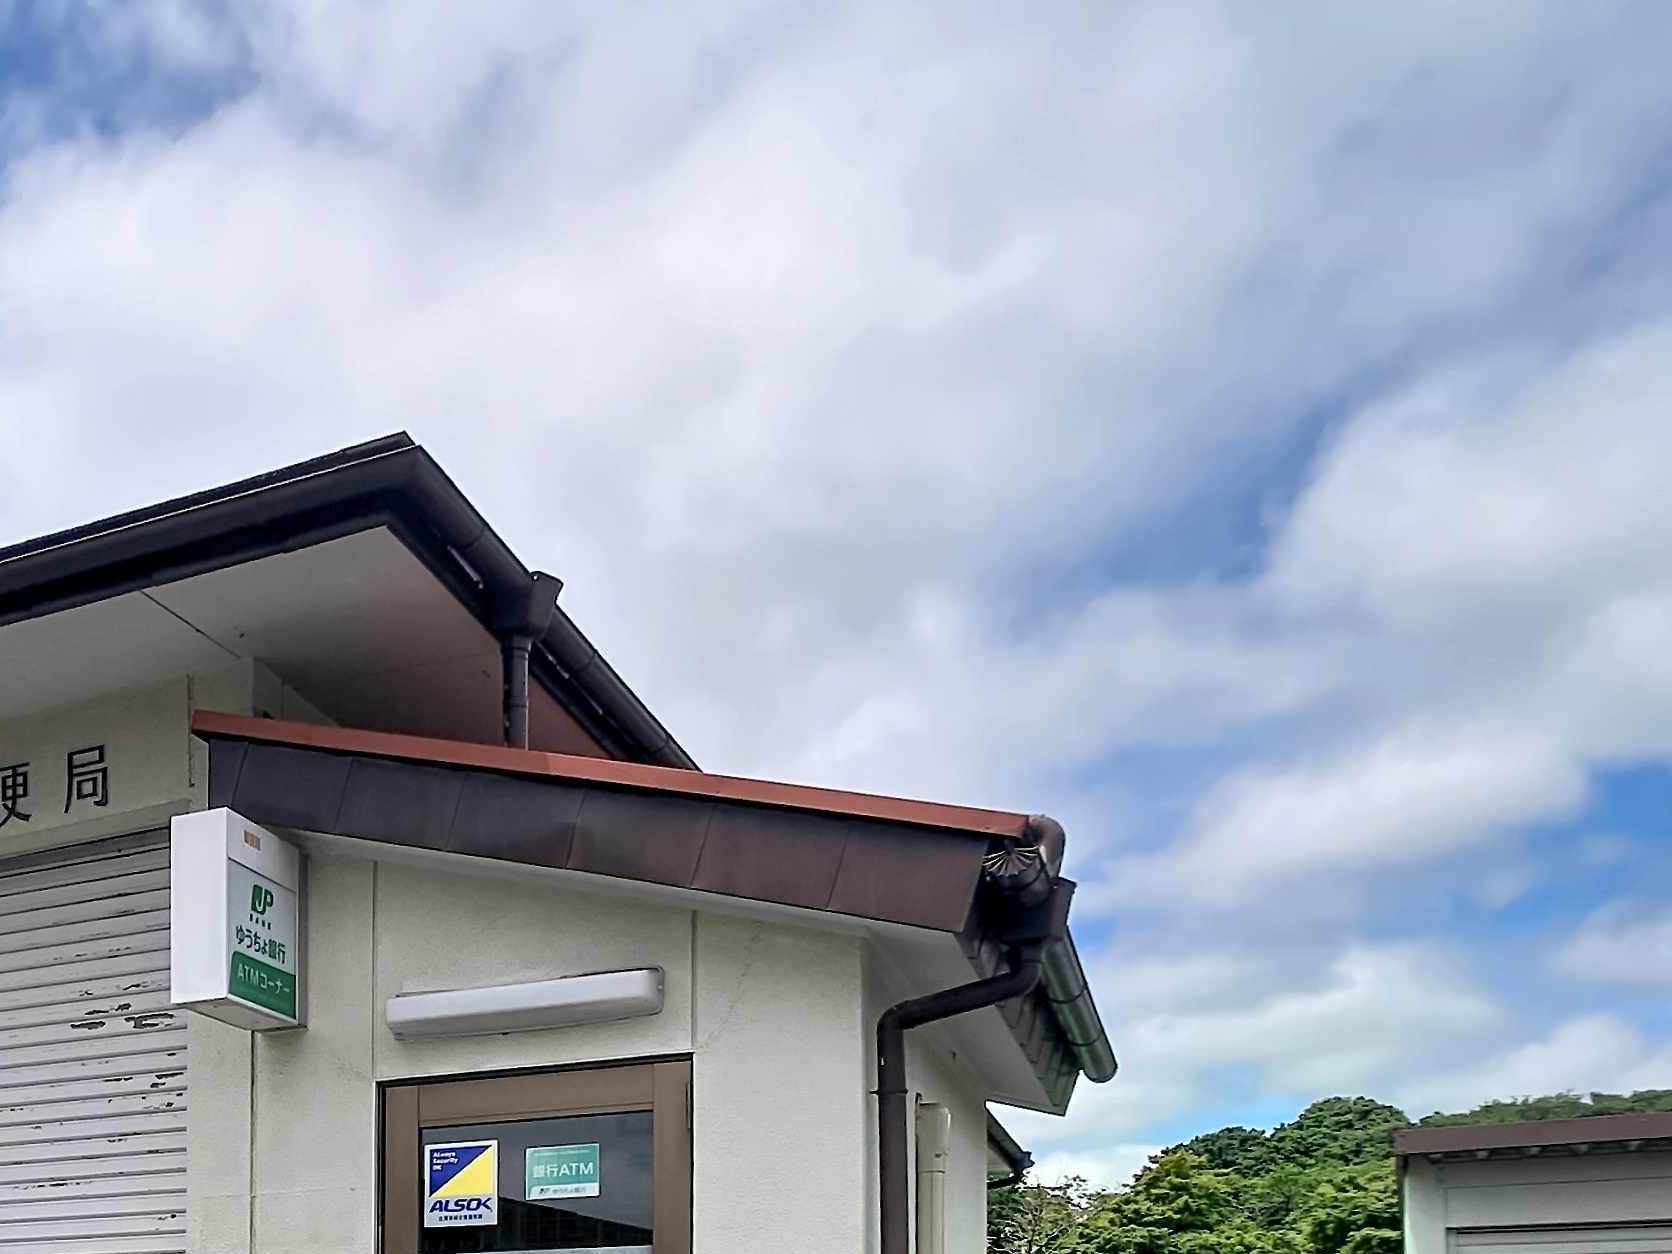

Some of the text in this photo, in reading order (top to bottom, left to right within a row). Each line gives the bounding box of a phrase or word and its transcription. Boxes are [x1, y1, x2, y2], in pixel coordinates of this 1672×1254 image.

[249, 913, 272, 931] BANK
[235, 924, 287, 965] ゆうちょ銀行
[237, 963, 291, 995] ATMコーナー
[532, 1161, 594, 1179] 銀行ATM
[429, 1198, 494, 1213] ALSOK
